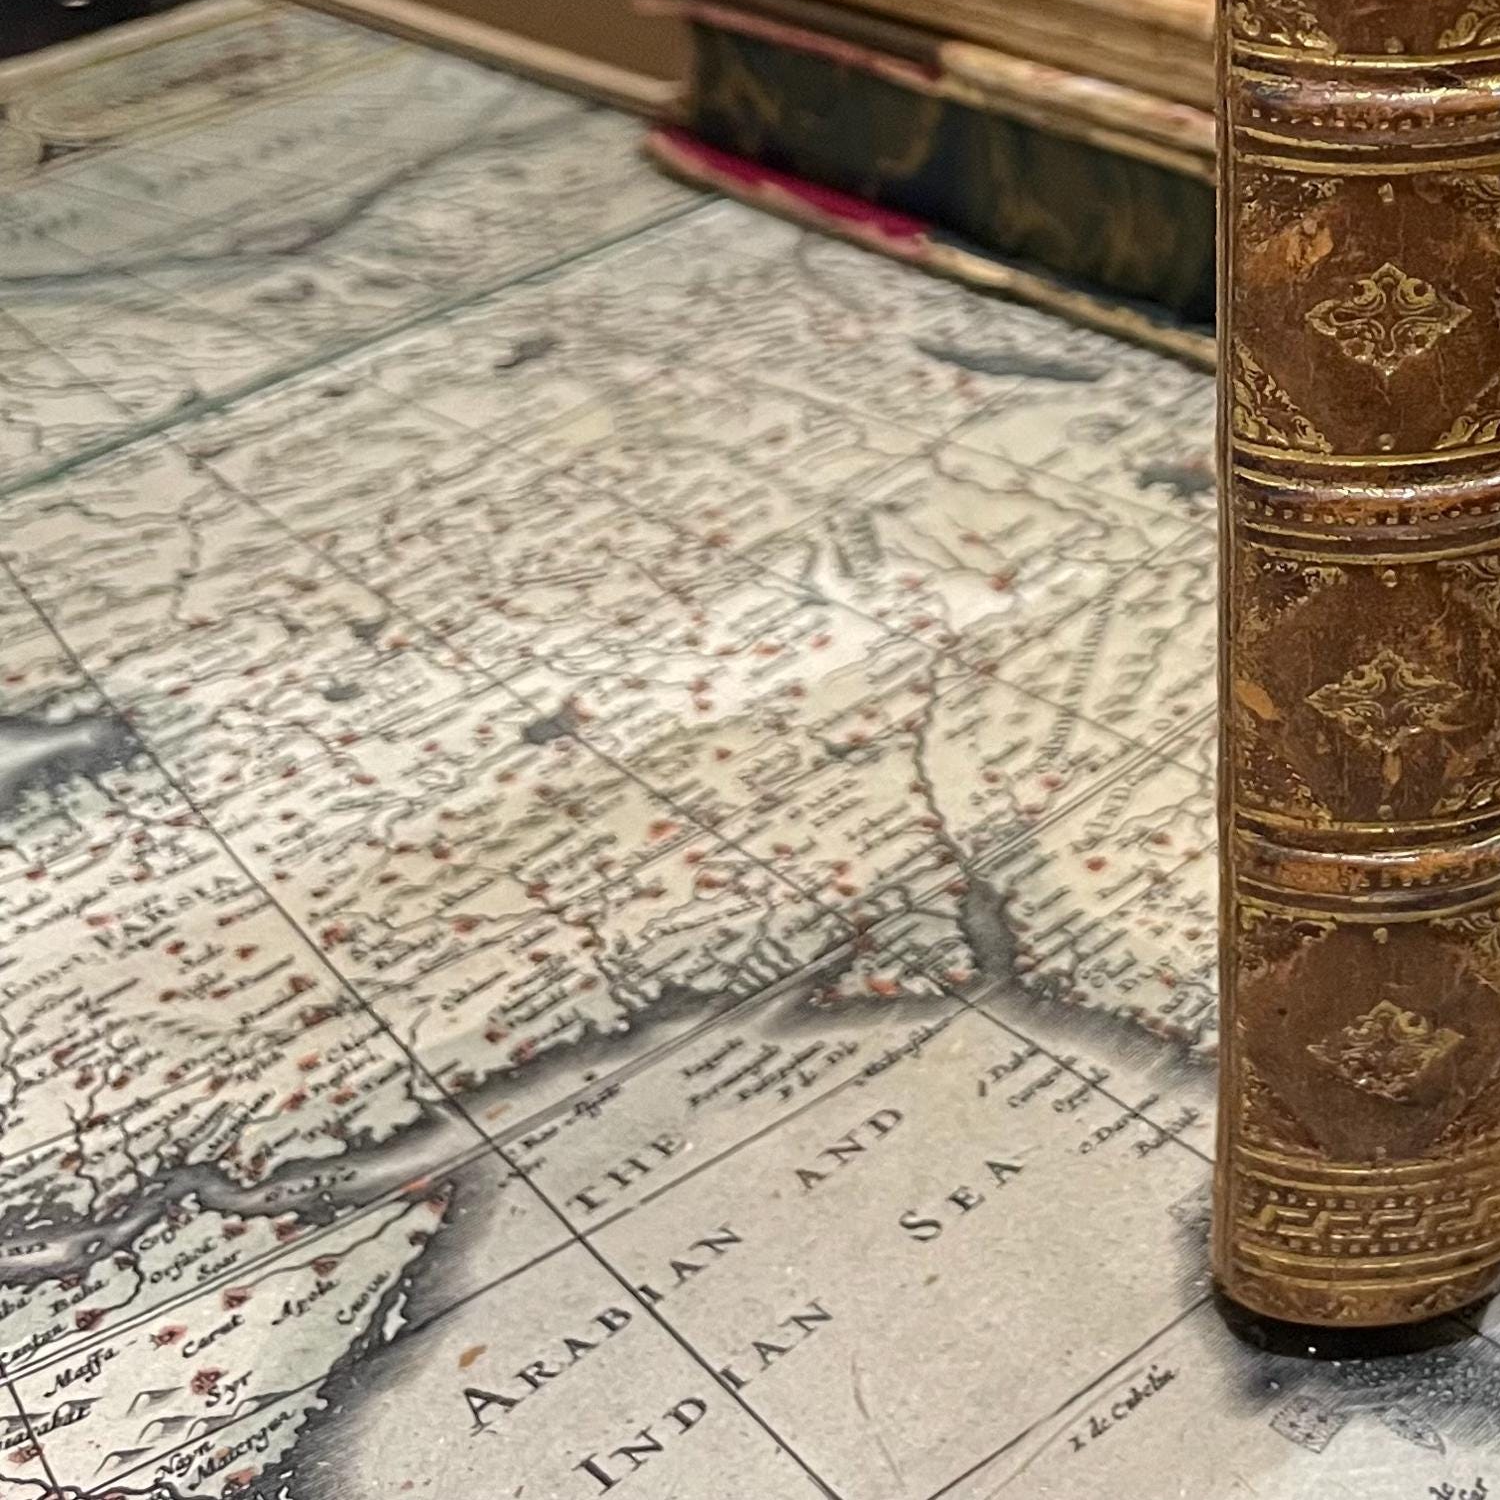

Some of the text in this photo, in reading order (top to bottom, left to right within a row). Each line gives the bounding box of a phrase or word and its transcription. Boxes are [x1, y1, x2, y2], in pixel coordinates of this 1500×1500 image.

[462, 1222, 744, 1437] ARABIAN
[796, 1107, 904, 1194] AND
[566, 1131, 687, 1214] THE
[573, 1156, 1023, 1495] INDIAN SEA
